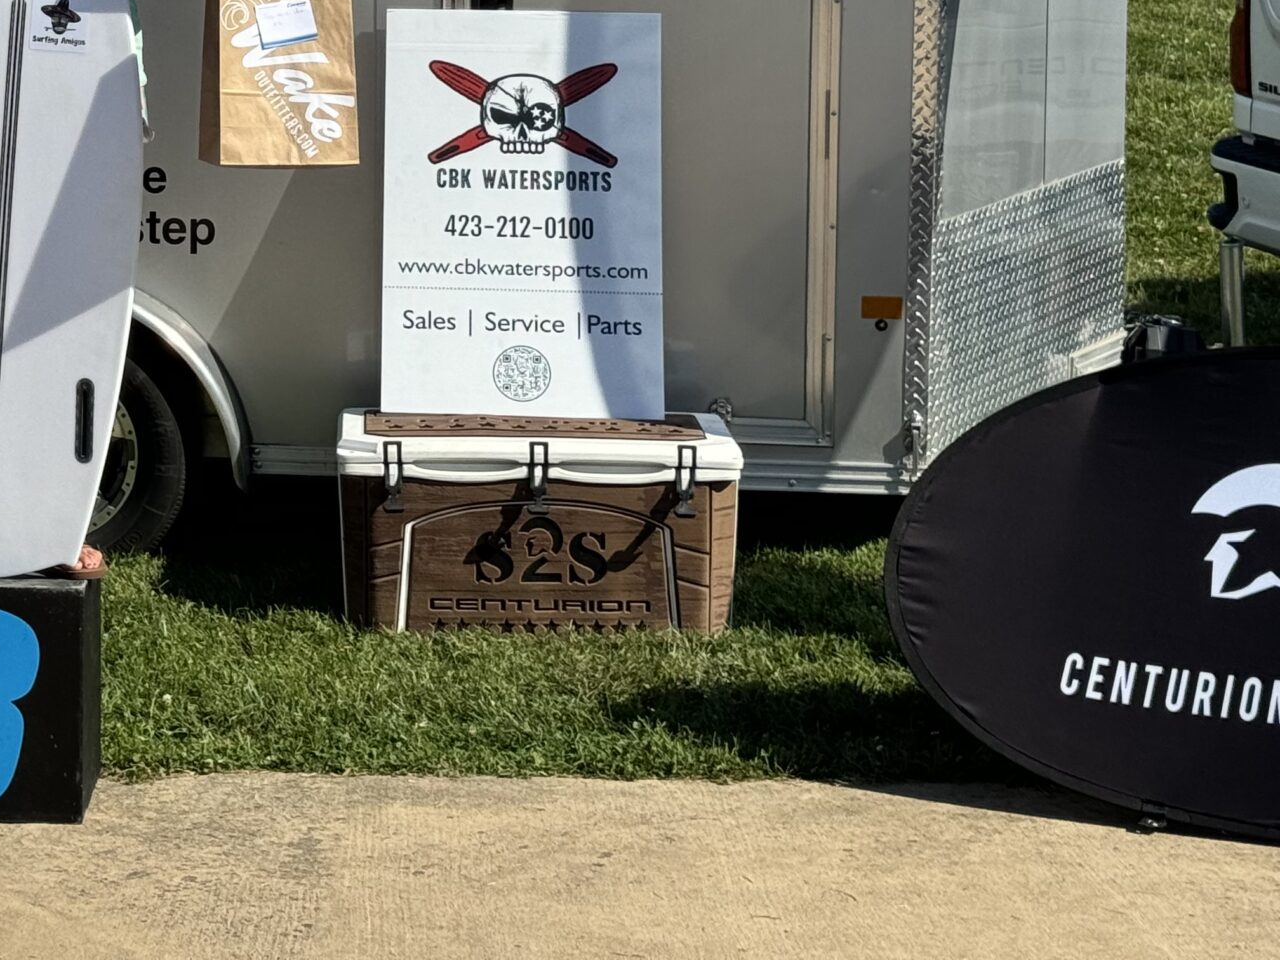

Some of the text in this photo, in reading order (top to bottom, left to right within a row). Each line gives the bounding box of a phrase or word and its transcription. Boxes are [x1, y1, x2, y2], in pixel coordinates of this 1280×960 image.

[32, 35, 86, 47] Surfing Amigos
[254, 70, 320, 159] OUTFITTERS.COM
[436, 168, 612, 192] CBK WATERSPORTS
[139, 211, 215, 254] tep
[445, 215, 594, 239] 423-212-0100
[398, 258, 648, 281] www.cbkwatersports.com
[403, 310, 642, 336] Sales Service Parts
[428, 597, 651, 614] CENTURION
